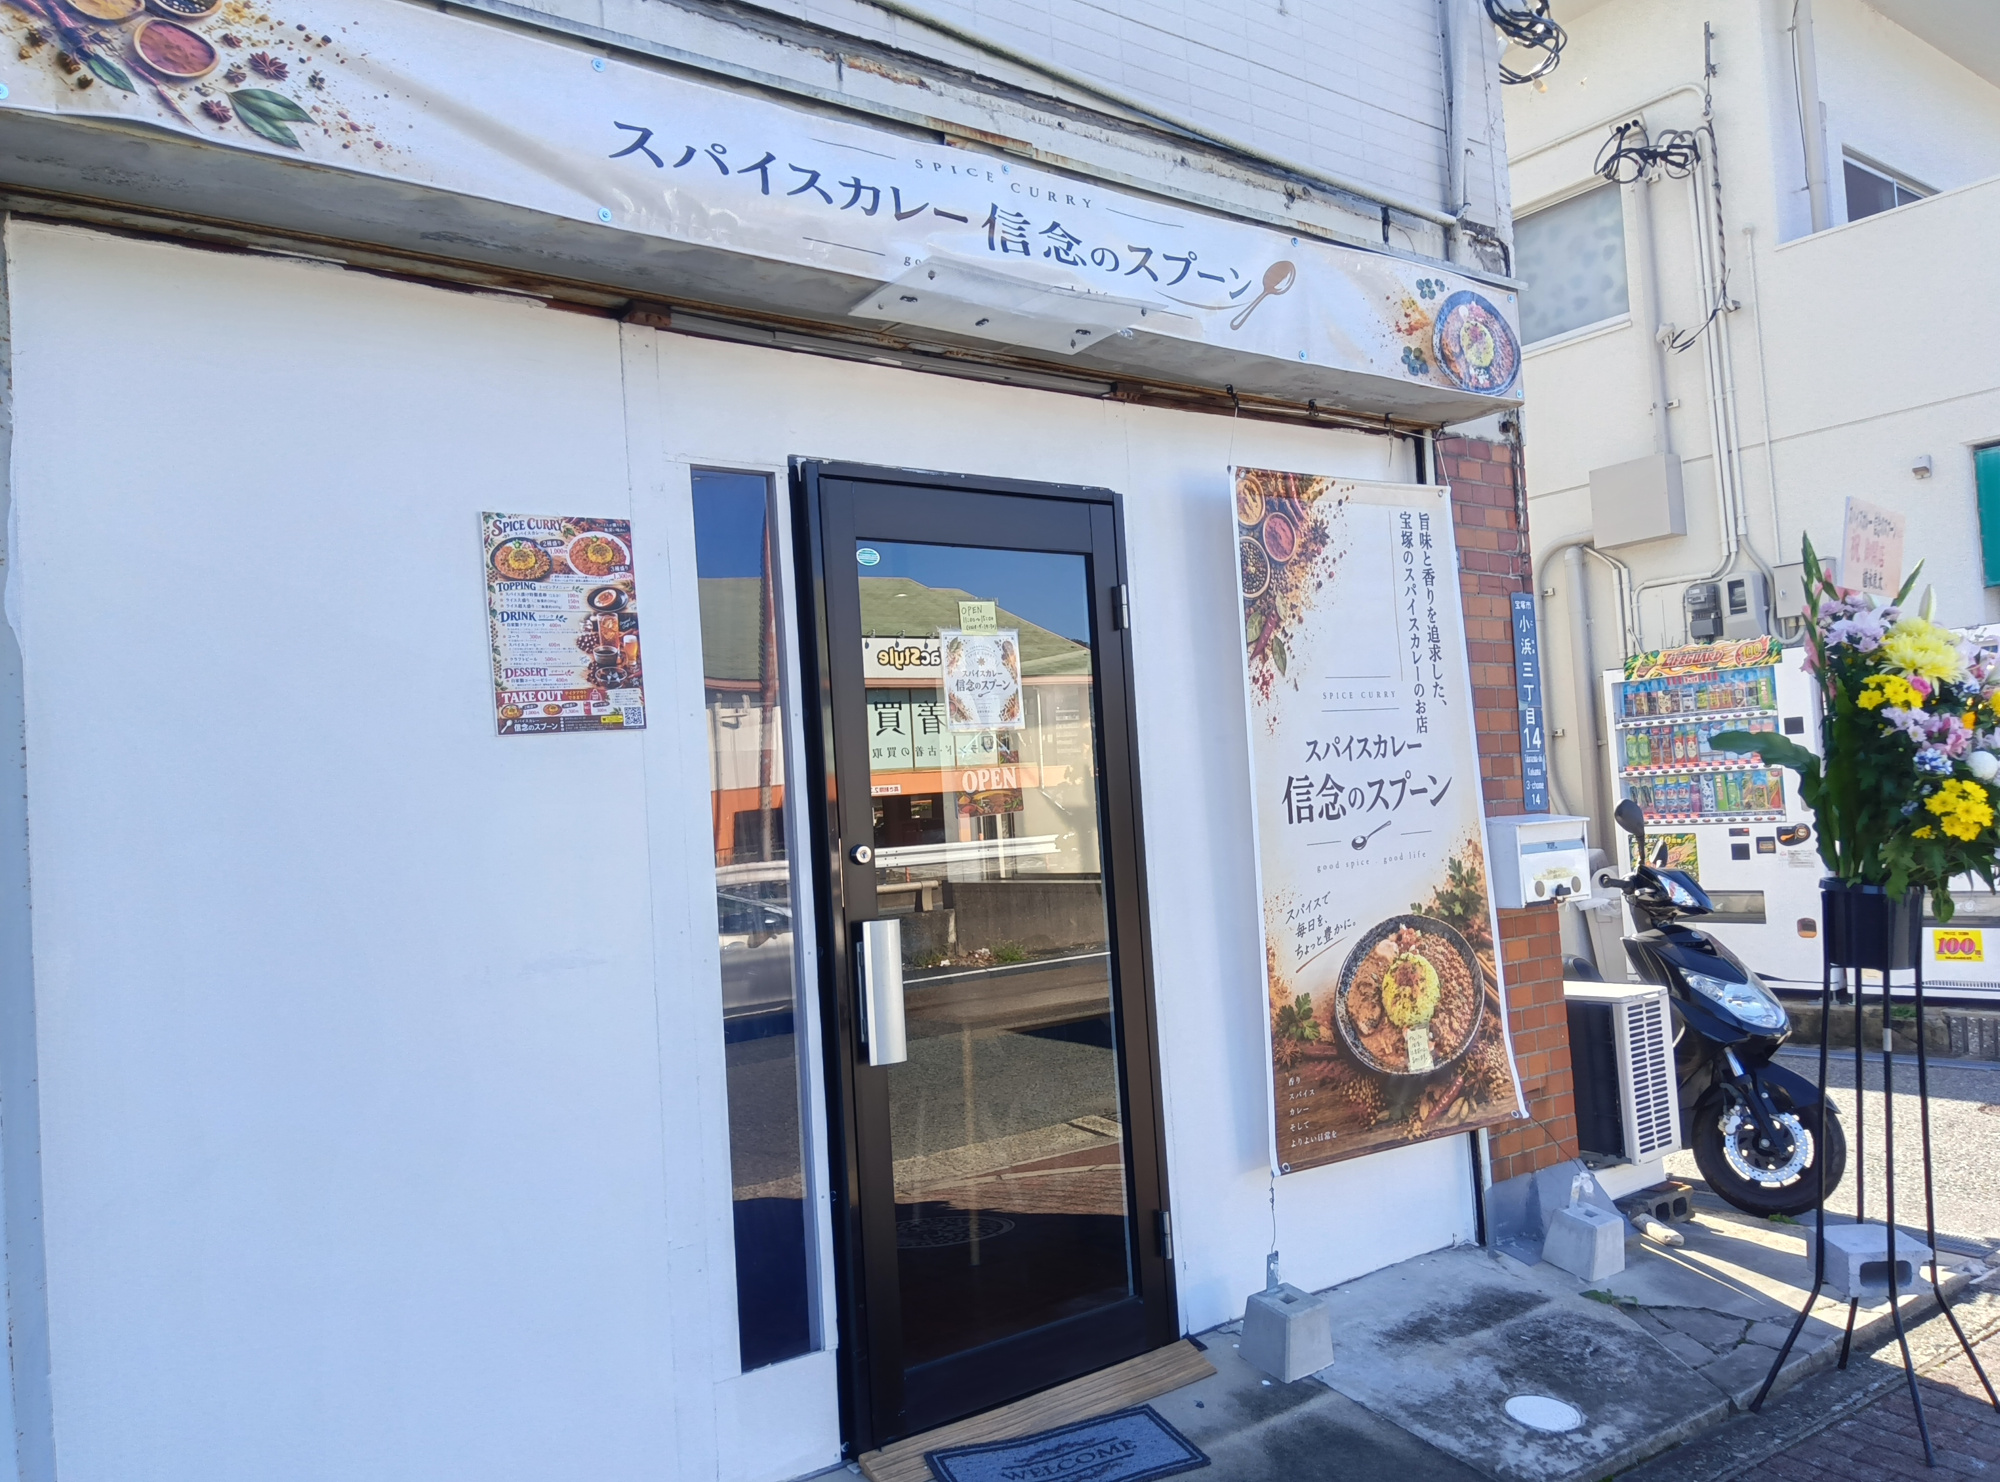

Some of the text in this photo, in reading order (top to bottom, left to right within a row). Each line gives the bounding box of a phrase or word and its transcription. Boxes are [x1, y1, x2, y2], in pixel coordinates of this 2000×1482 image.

[914, 158, 1093, 209] SPICE CURRY
[608, 120, 1252, 300] スパイスカレー 信念のスプーン
[492, 517, 564, 537] SPICE CURRY
[496, 581, 536, 592] TOPPING
[501, 611, 537, 622] DRINK
[961, 605, 983, 616] OPEN
[1418, 512, 1447, 706] 旨味と香りを追求した、
[1399, 511, 1428, 734] 宝塚のスパイスカレーのお店
[1741, 643, 1763, 660] 100
[503, 667, 548, 679] DESSERT
[962, 670, 1003, 678] スパイスカレー
[955, 679, 1011, 692] 信念のスプーン
[501, 690, 564, 703] TAKE OUT
[1322, 690, 1397, 700] SPICE CURRY
[1523, 727, 1542, 749] 14
[1304, 734, 1422, 763] スパイスカレー
[962, 767, 1018, 793] OPEN
[1281, 769, 1452, 825] 信念のスプーン
[1531, 793, 1541, 805] 14
[1316, 851, 1427, 874] good spice good life
[1285, 891, 1331, 925] スパイスで
[1289, 1106, 1310, 1116] カレー
[1290, 1120, 1310, 1132] そして
[1001, 1438, 1138, 1482] WELCOME
